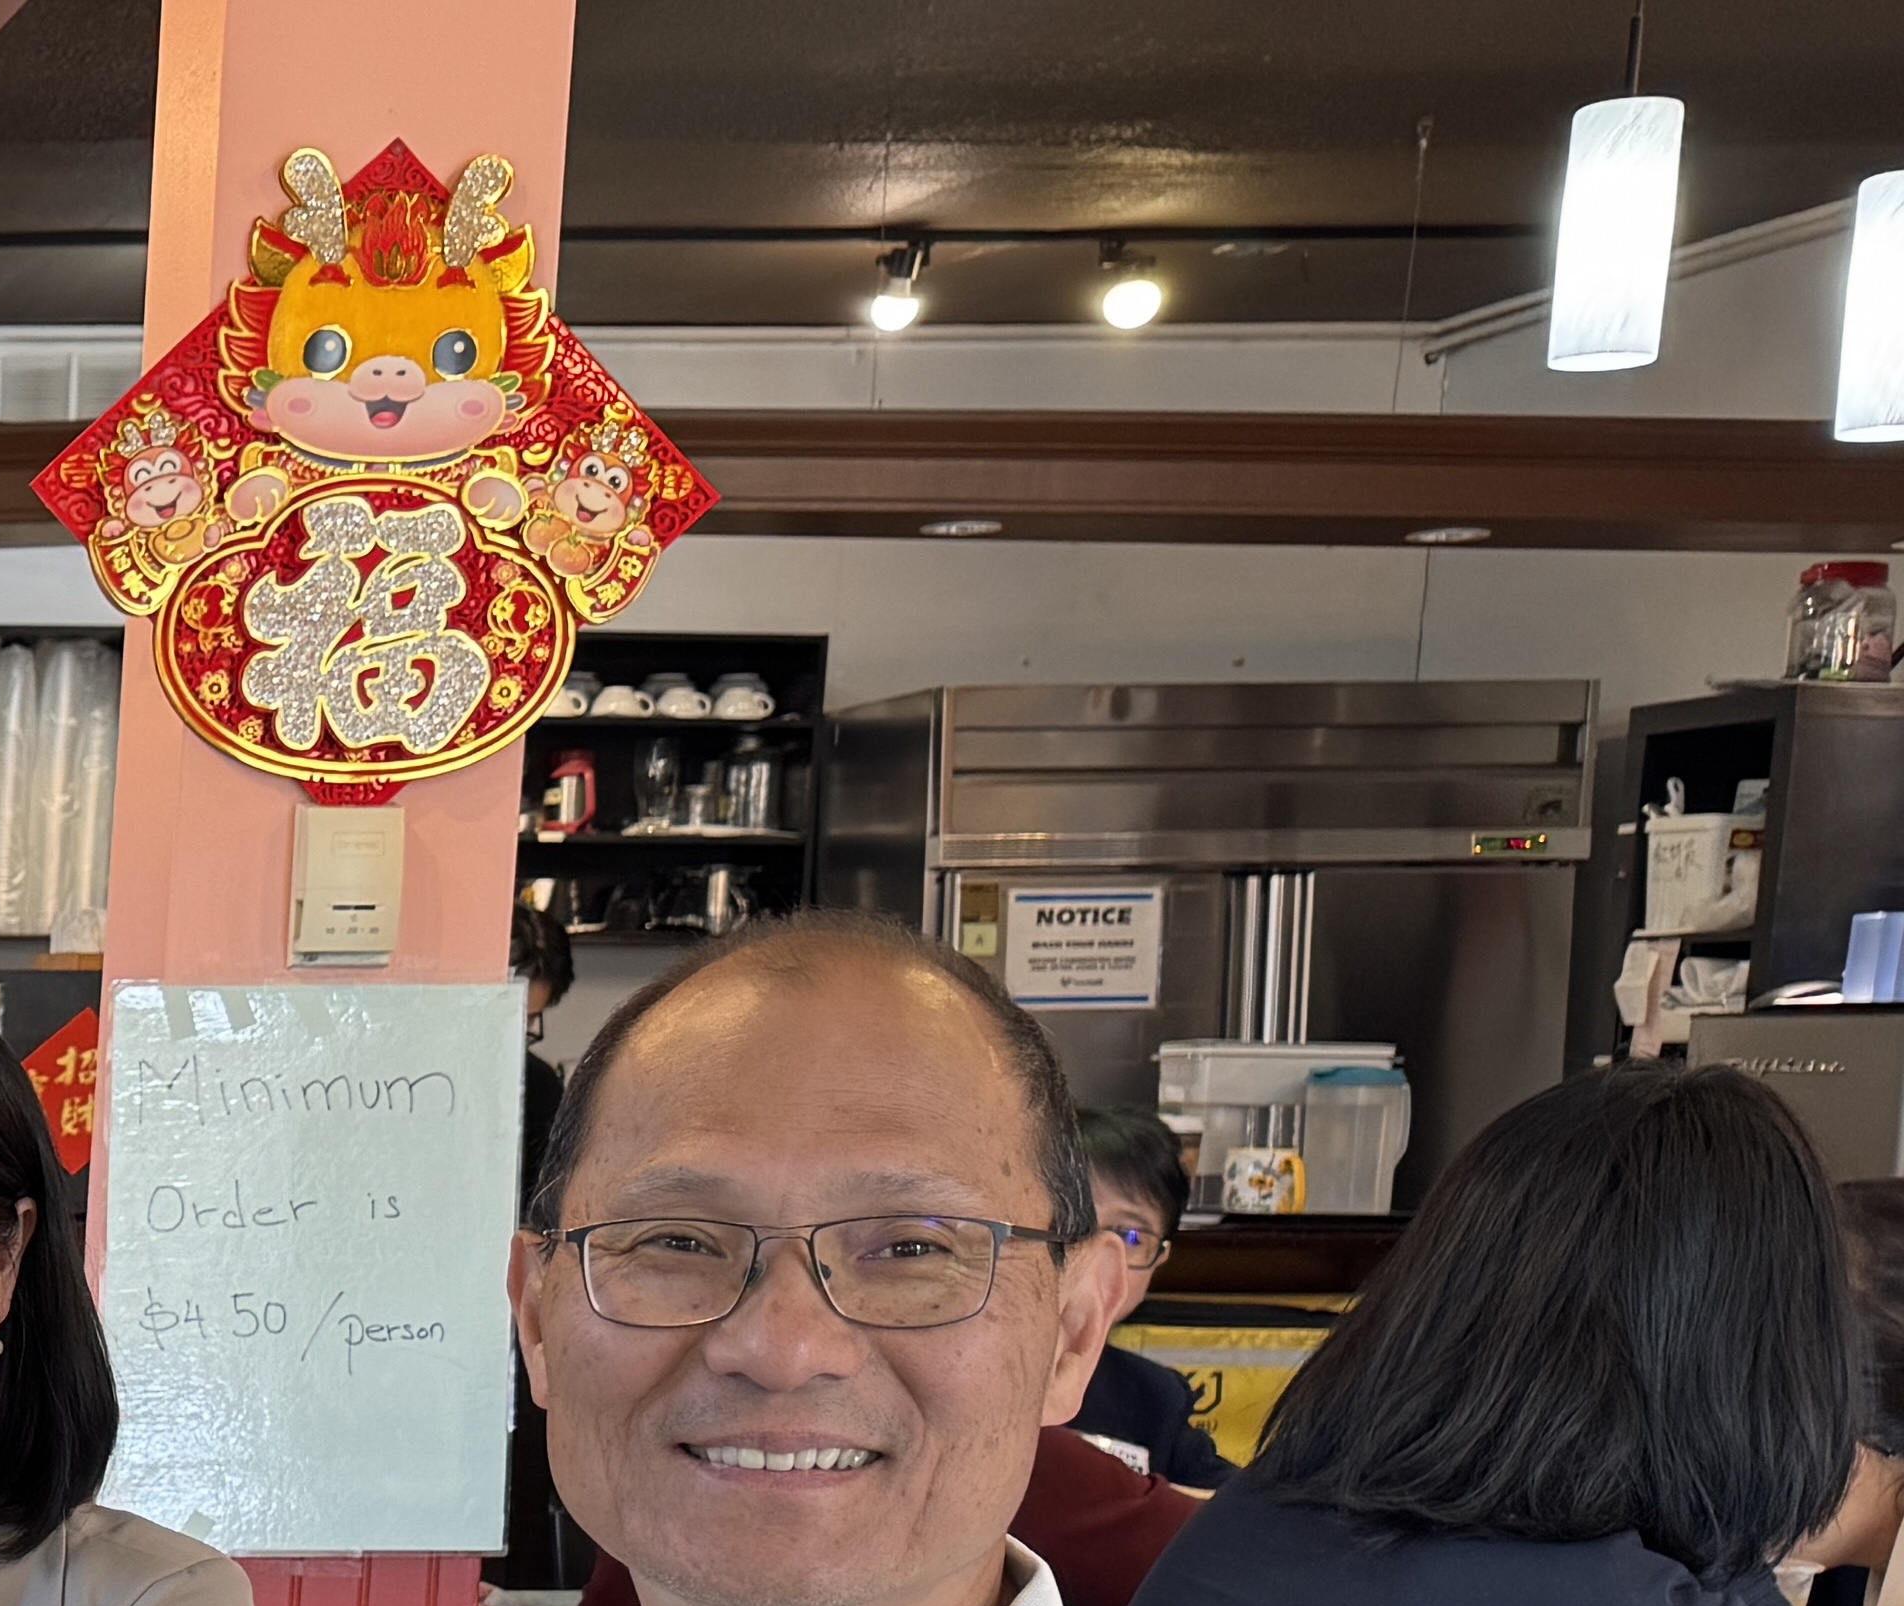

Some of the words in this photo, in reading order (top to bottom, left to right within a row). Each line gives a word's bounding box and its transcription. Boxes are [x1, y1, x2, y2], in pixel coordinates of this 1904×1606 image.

[244, 497, 490, 753] 福
[1036, 907, 1132, 926] NOTICE
[137, 1055, 455, 1125] Minimum
[147, 1181, 318, 1233] Order
[370, 1192, 400, 1219] is
